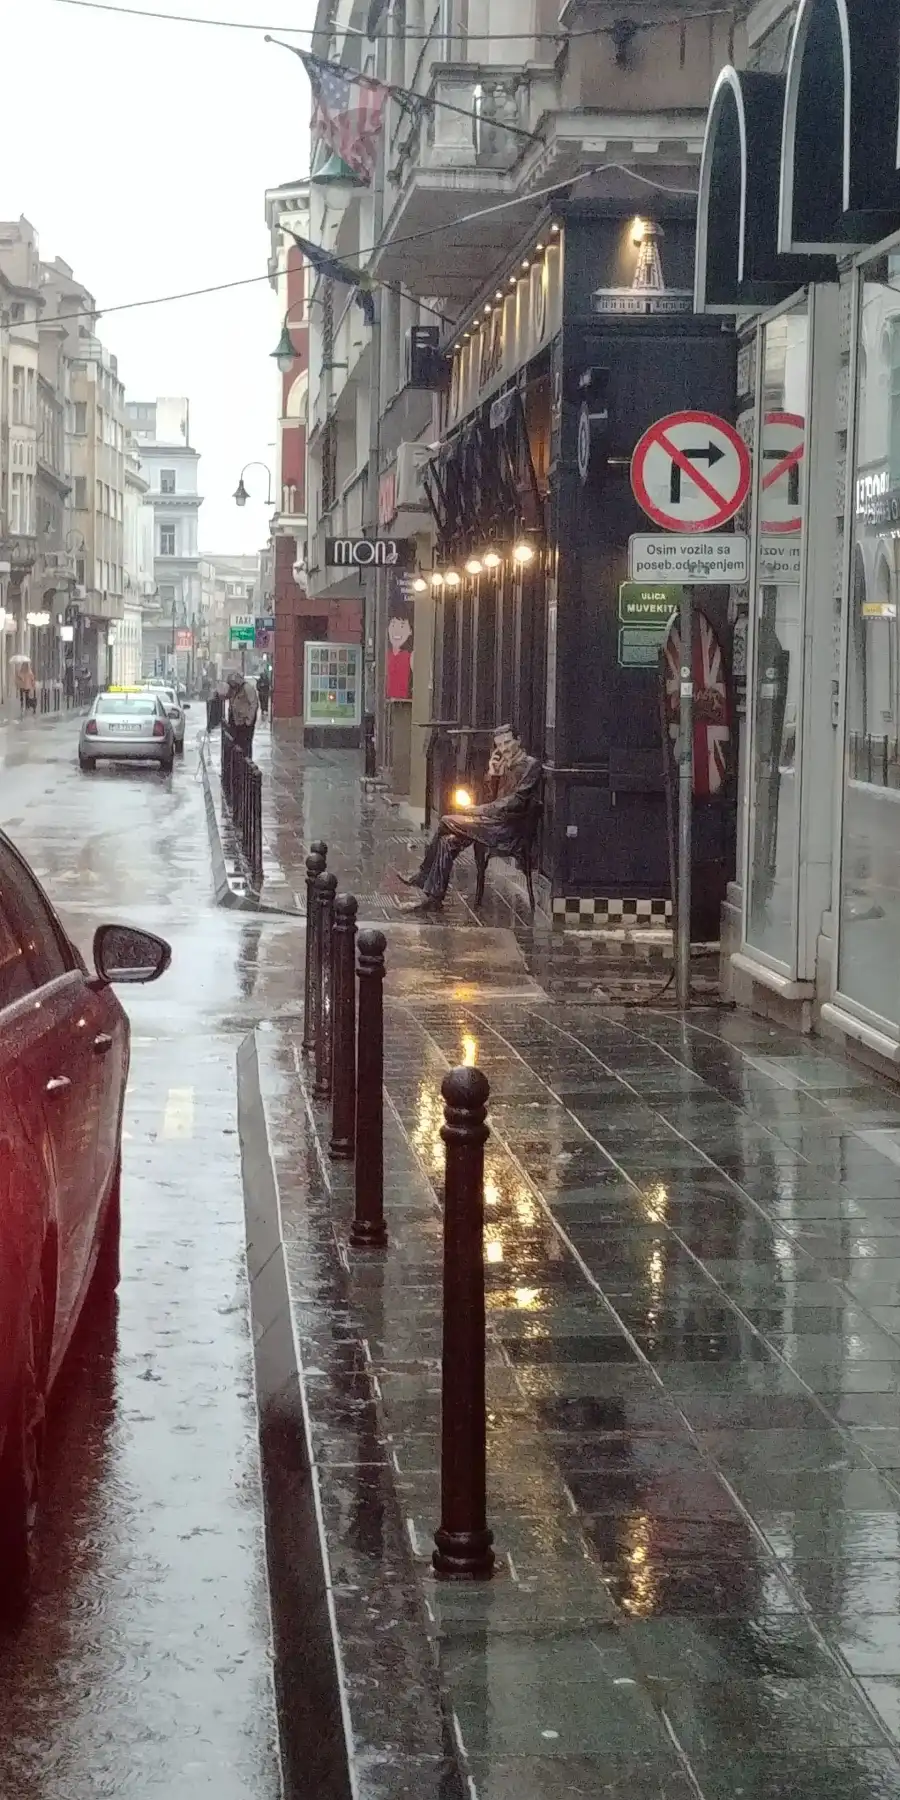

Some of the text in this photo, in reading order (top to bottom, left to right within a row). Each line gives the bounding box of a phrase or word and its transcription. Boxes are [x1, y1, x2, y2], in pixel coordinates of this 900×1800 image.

[646, 544, 731, 555] Osim vozila sa
[641, 592, 666, 600] ULICA
[235, 615, 252, 625] TAXI
